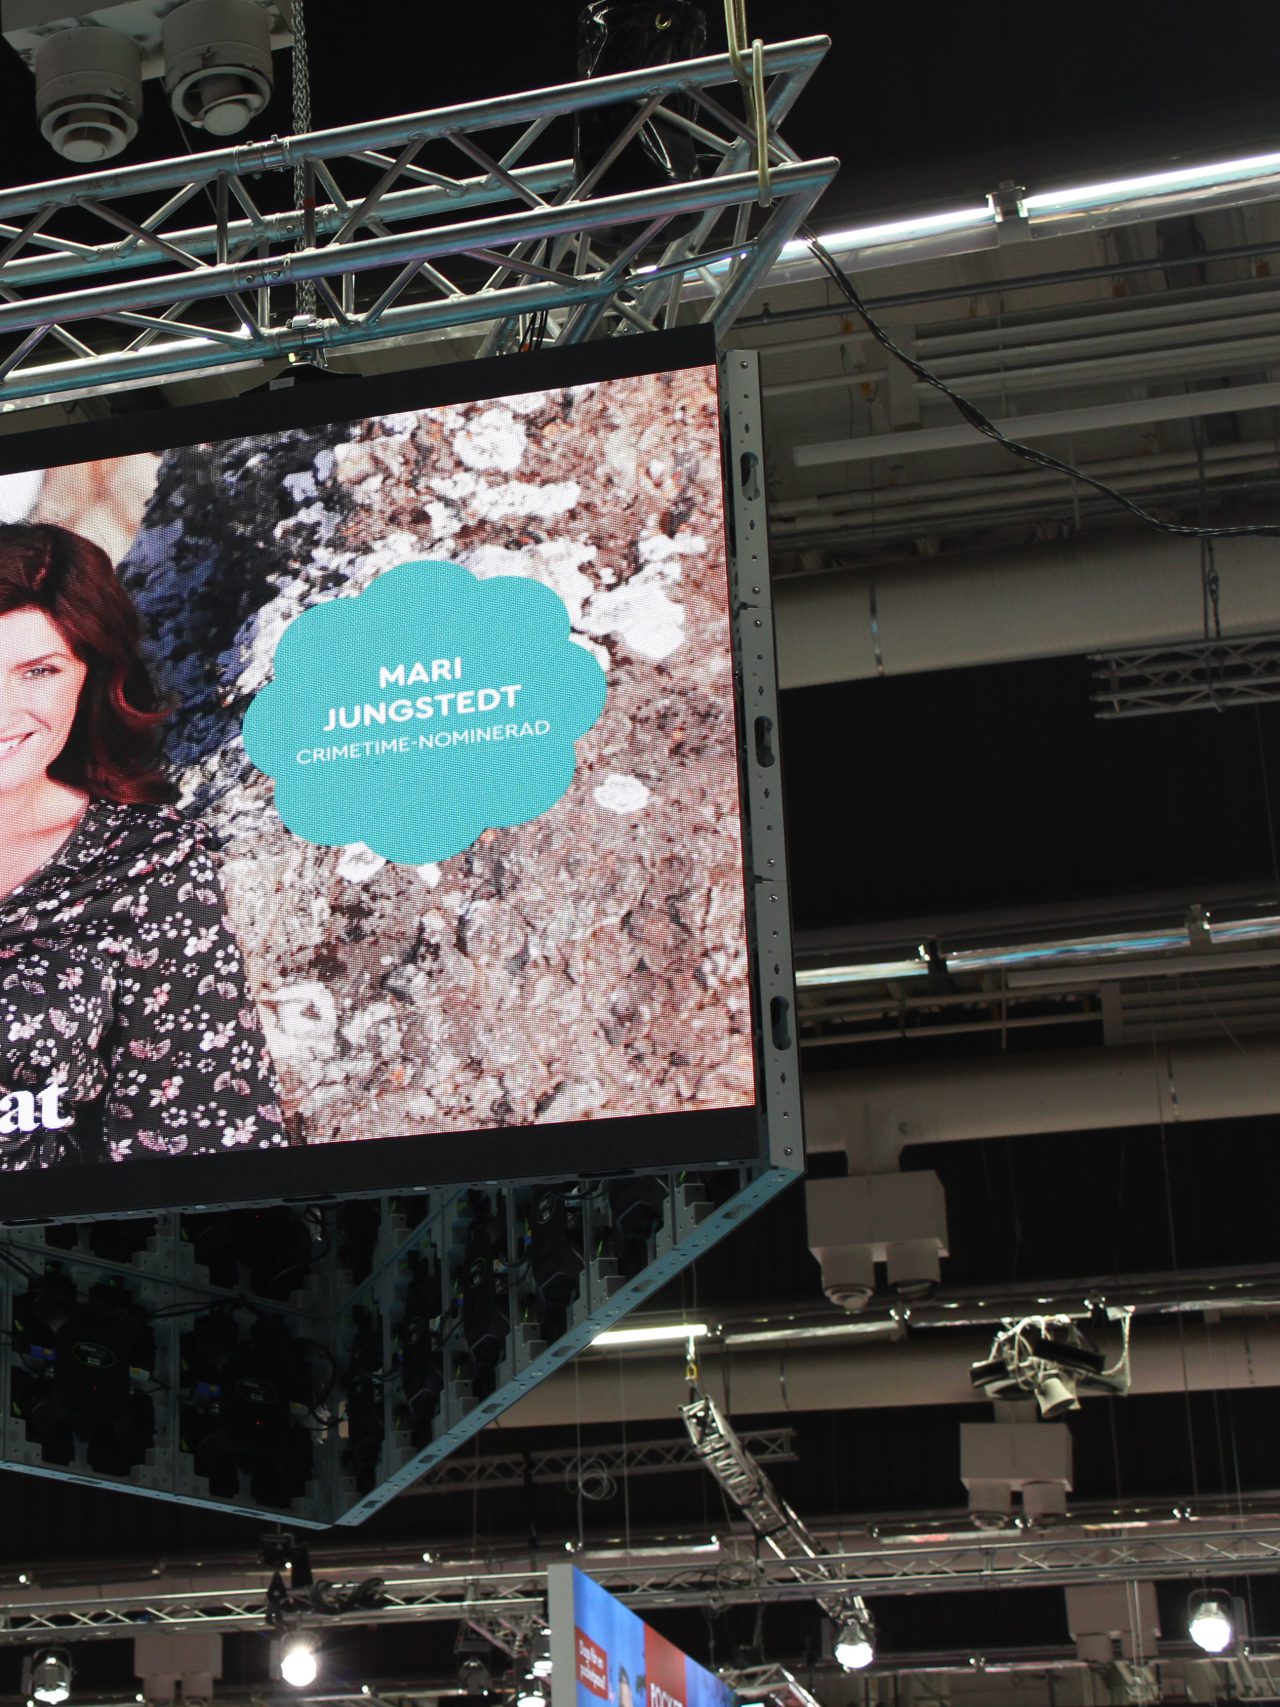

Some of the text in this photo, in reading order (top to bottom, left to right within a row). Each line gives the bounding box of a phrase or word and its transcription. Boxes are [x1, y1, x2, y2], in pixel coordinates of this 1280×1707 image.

[378, 656, 462, 689] MARI
[322, 684, 522, 732] JUNGSTEDT
[296, 720, 551, 766] CRIMETIME-NOMINERAD
